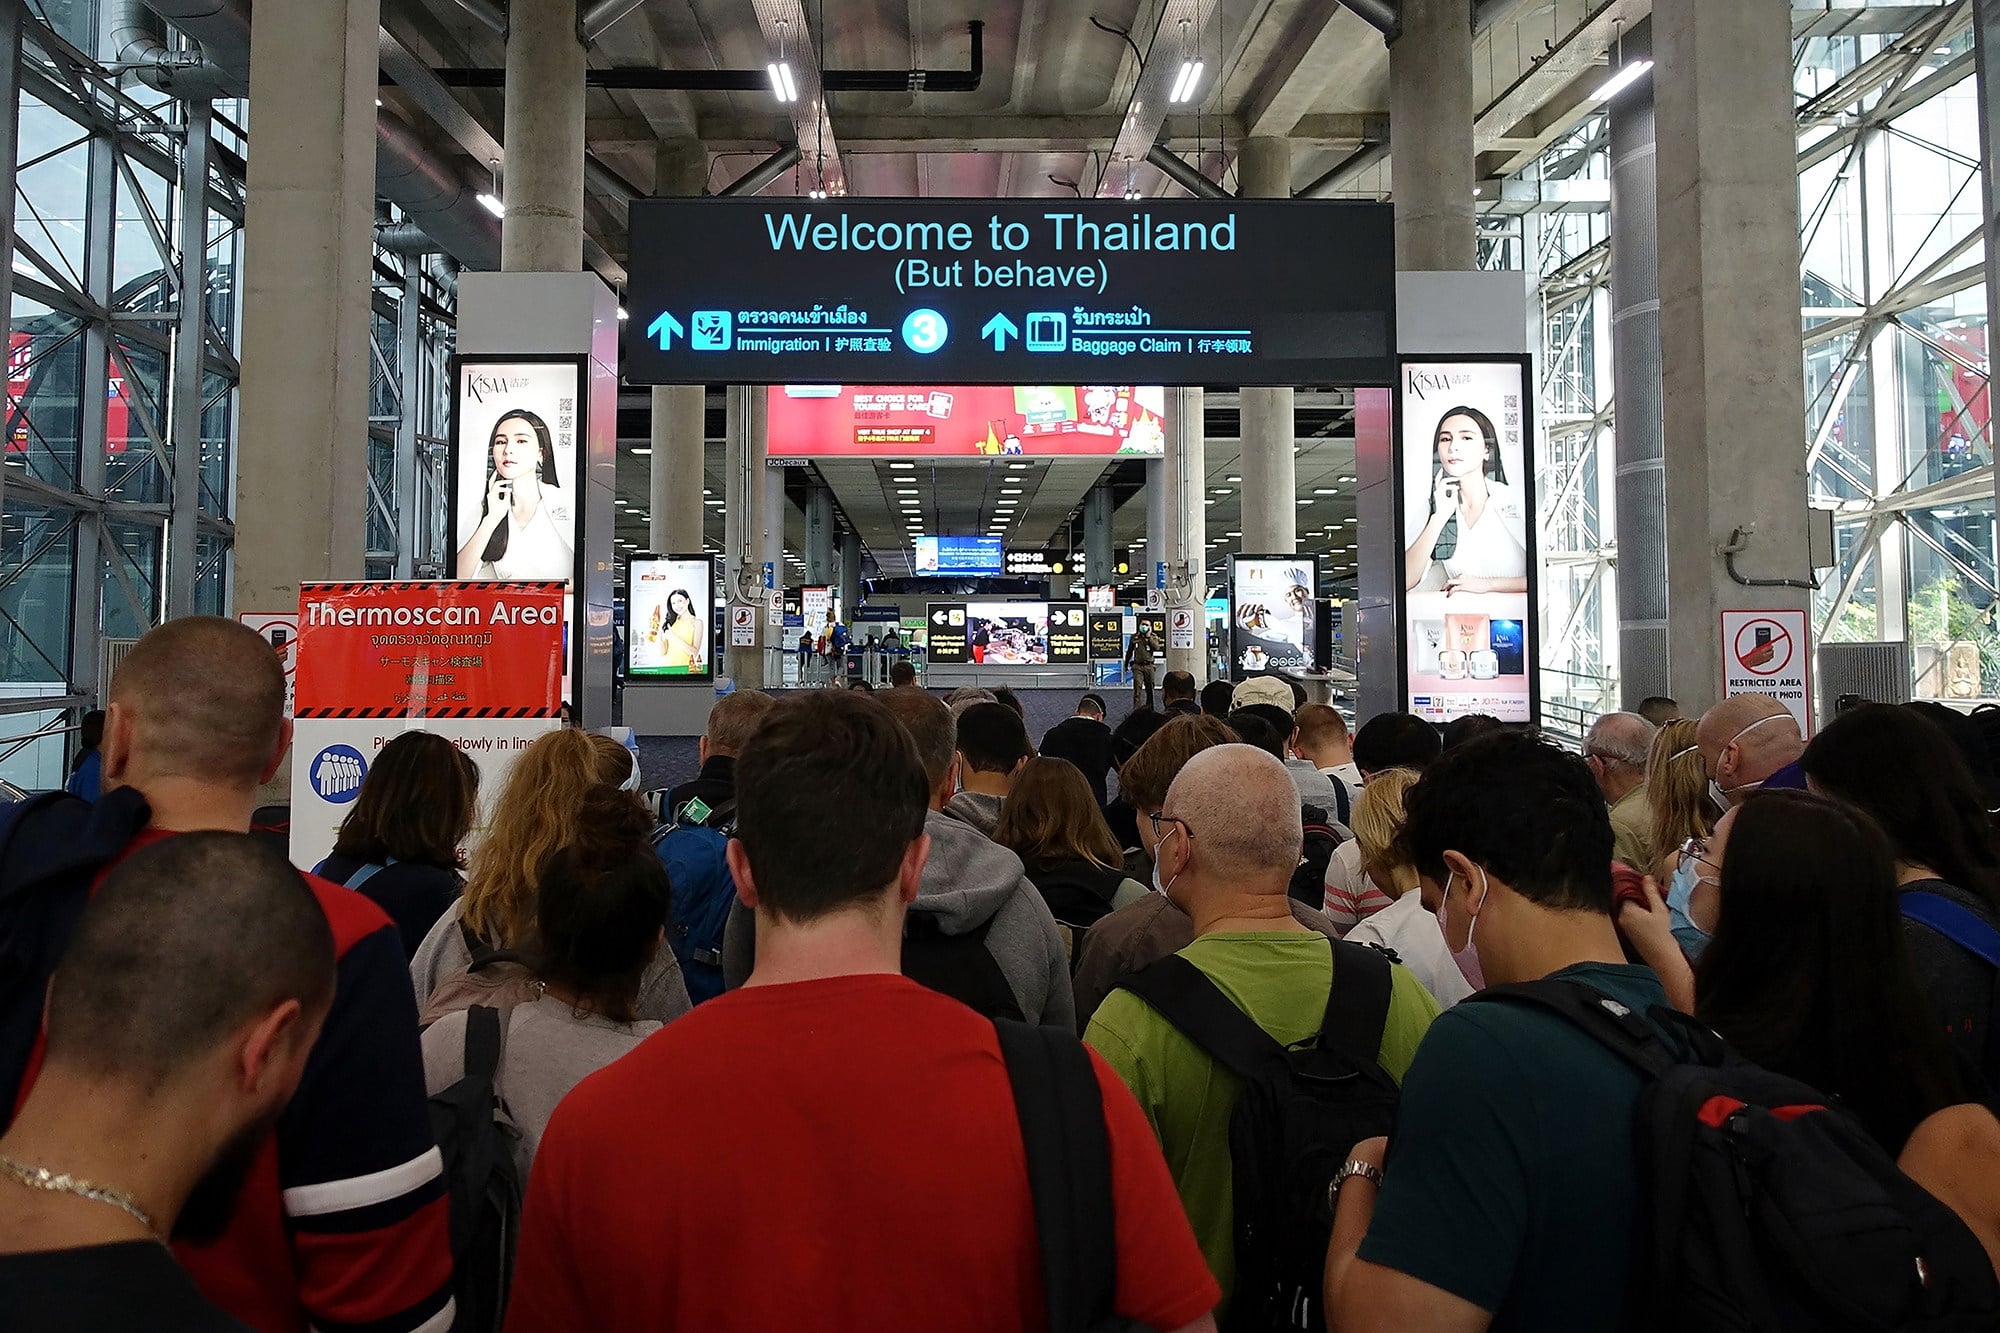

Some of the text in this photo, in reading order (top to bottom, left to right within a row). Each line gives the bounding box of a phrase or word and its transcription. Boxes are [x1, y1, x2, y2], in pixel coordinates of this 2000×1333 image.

[764, 213, 1237, 252] Welcome to Thailand
[894, 259, 1108, 295] (But behave)
[737, 304, 868, 325] ตรวจคนเข้าเมือง
[1072, 305, 1151, 326] รับกระเป๋า
[912, 314, 937, 348] 3
[736, 336, 820, 355] Immigration
[834, 336, 892, 353] 护照查验
[1072, 337, 1182, 356] Baggage Claim
[1197, 338, 1253, 354] 行李领取
[769, 458, 806, 466] JCDecaux
[307, 601, 558, 626] Thermoscan Area
[370, 630, 493, 649] จุดตรวจวัดอุณหภูมิ
[1729, 679, 1802, 687] RESTRICTED AREA
[1779, 691, 1803, 699] PHOTO
[453, 736, 493, 752] slowly
[497, 736, 508, 750] in
